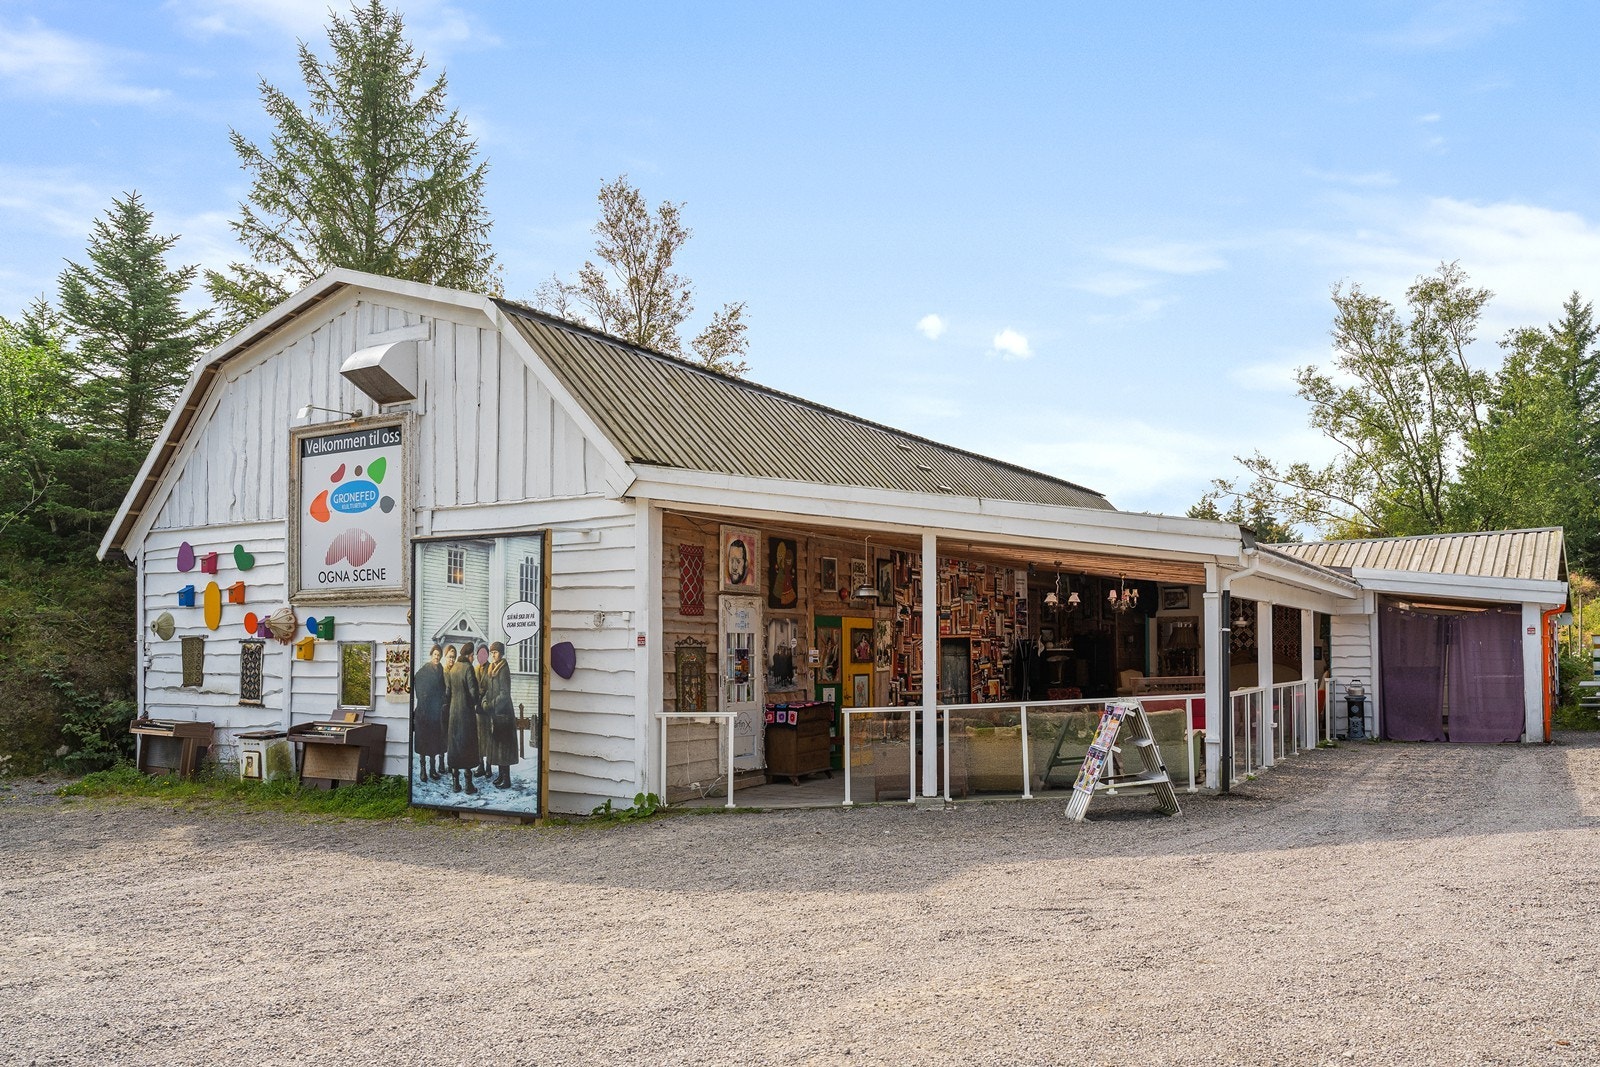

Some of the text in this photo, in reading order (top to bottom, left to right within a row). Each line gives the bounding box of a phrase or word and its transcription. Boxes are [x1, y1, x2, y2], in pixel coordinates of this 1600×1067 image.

[305, 430, 400, 454] Velkommen til oss
[333, 490, 376, 504] GRØNEFED
[318, 568, 386, 584] OGNA SCENE
